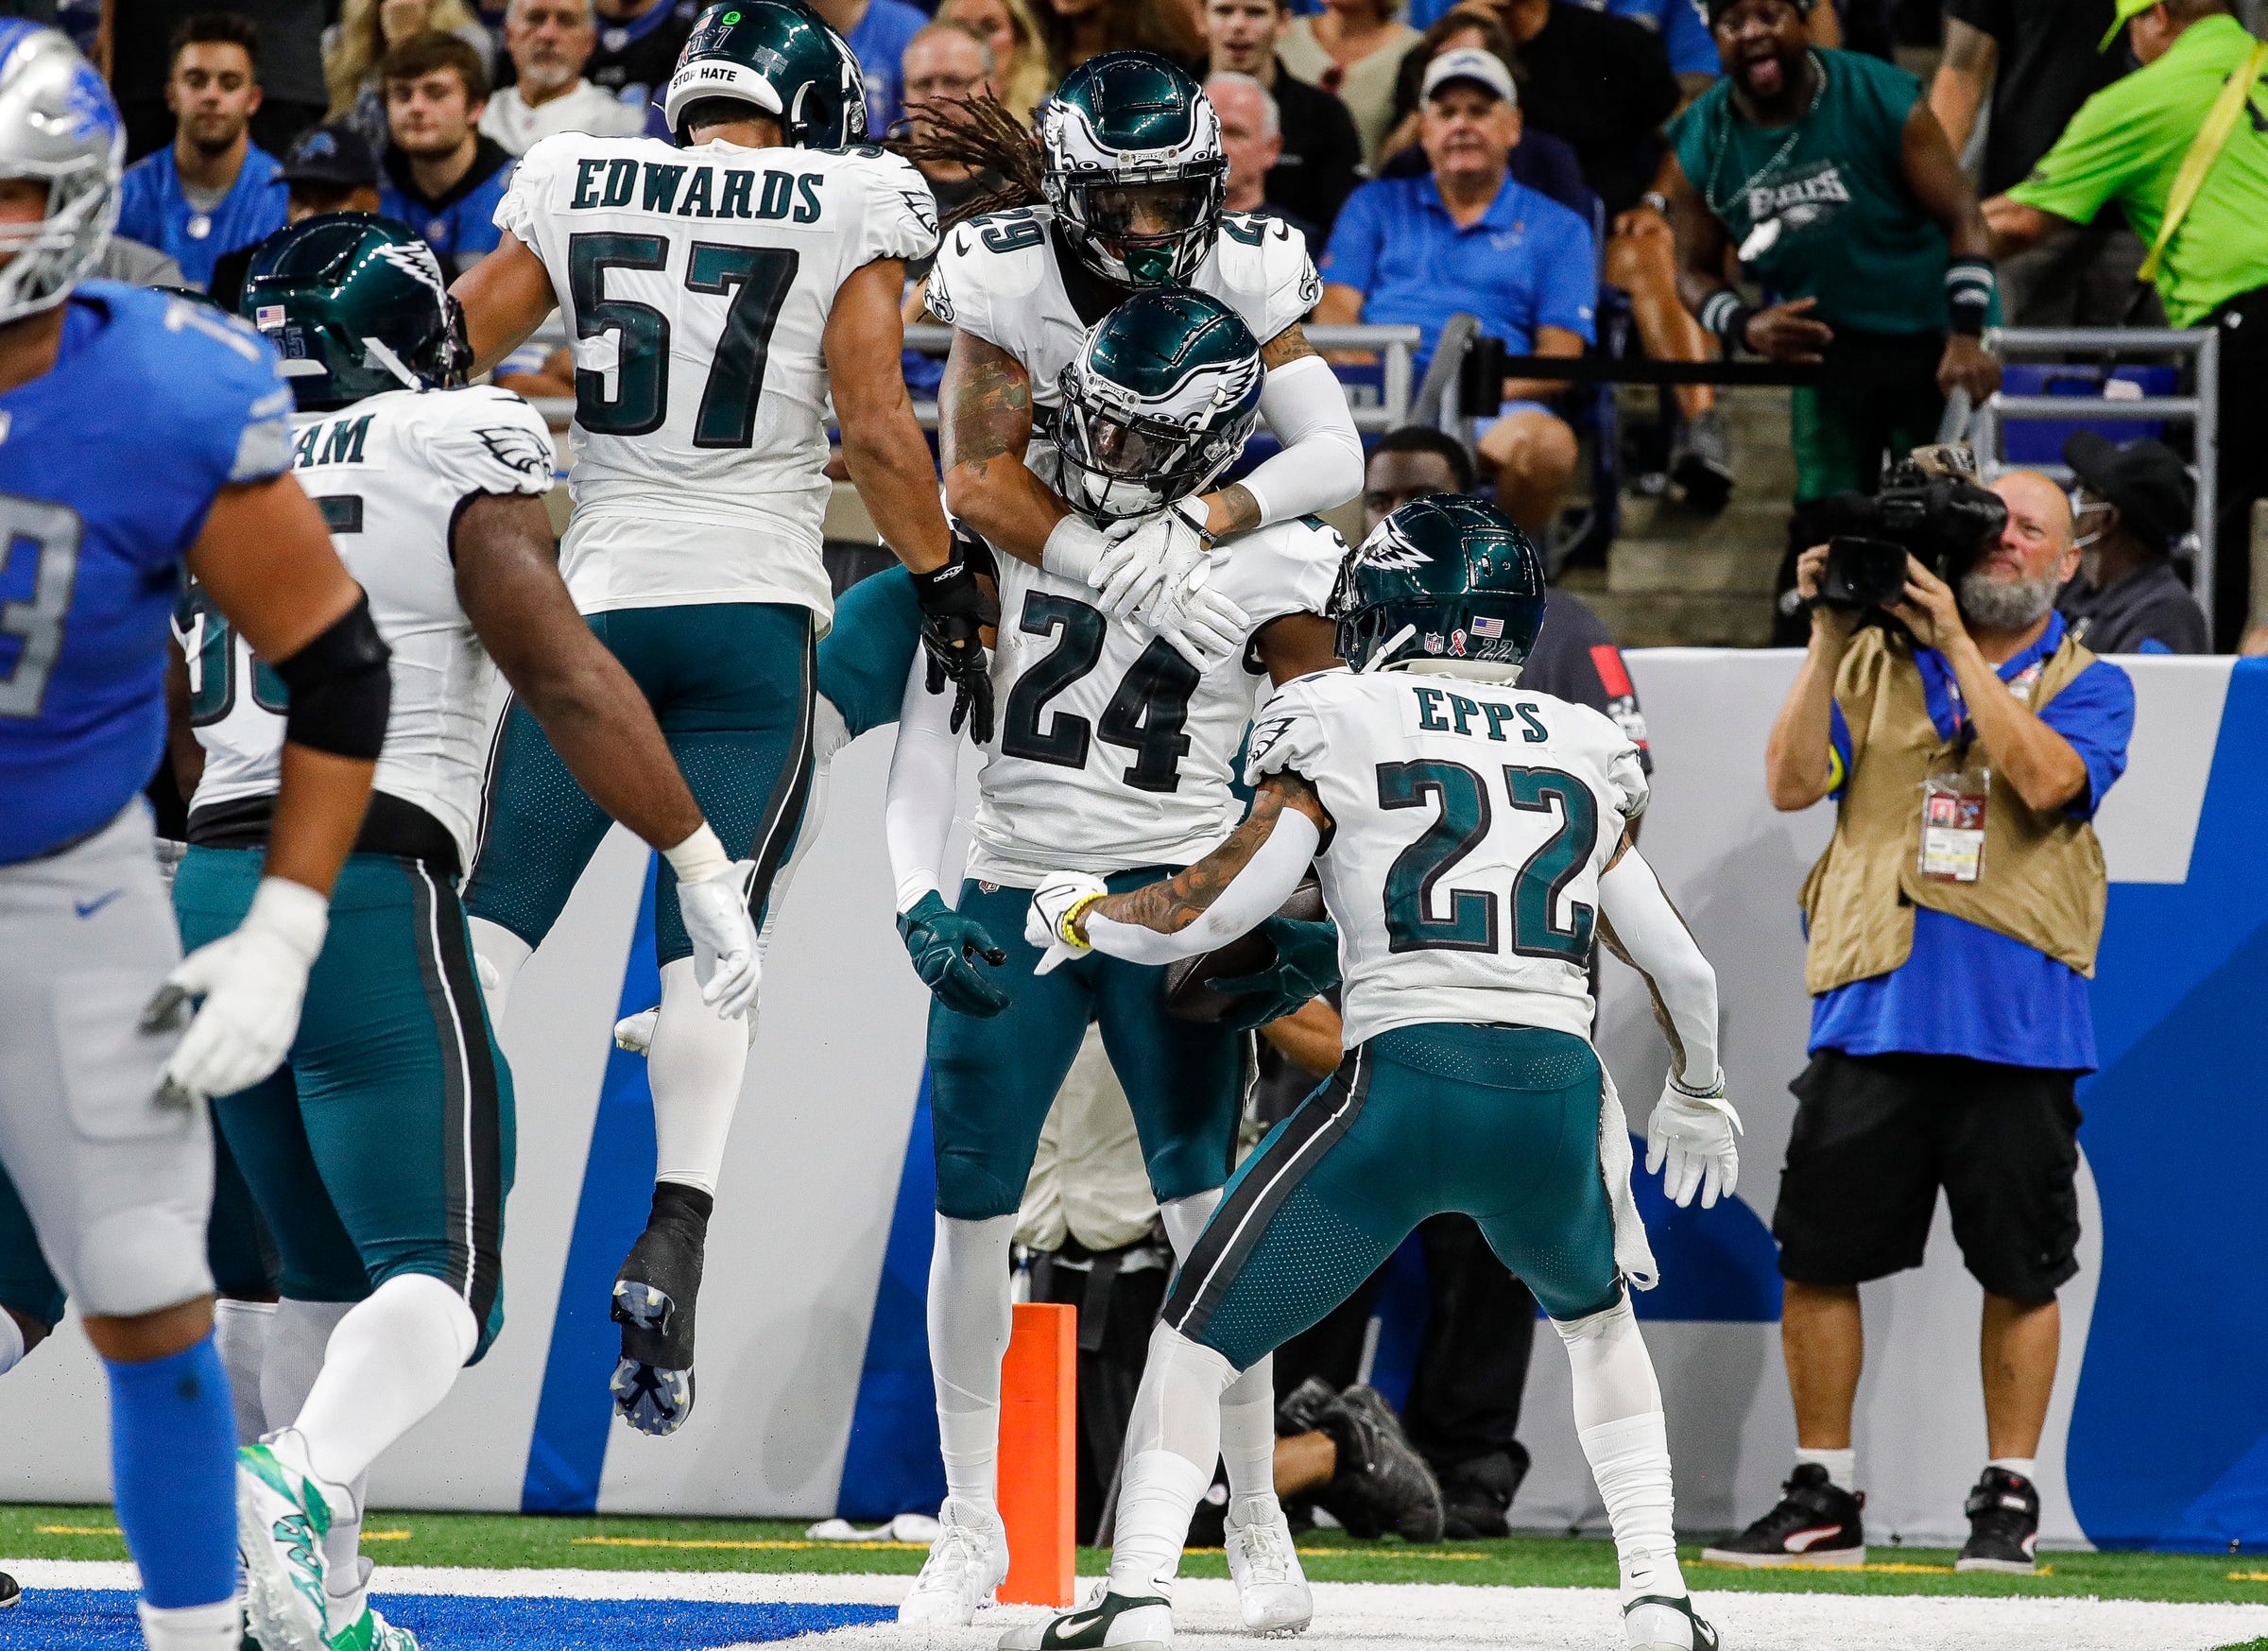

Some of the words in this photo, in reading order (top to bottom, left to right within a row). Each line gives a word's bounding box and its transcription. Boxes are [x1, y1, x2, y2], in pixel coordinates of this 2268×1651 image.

[700, 68, 737, 82] HATE
[570, 158, 823, 224] EDWARDS
[967, 207, 1046, 254] 29
[568, 232, 799, 449] 57
[289, 413, 377, 469] AM
[1474, 636, 1515, 663] 22
[1001, 588, 1201, 794] 24
[1412, 686, 1550, 744] EPPS
[1375, 758, 1599, 970] 22
